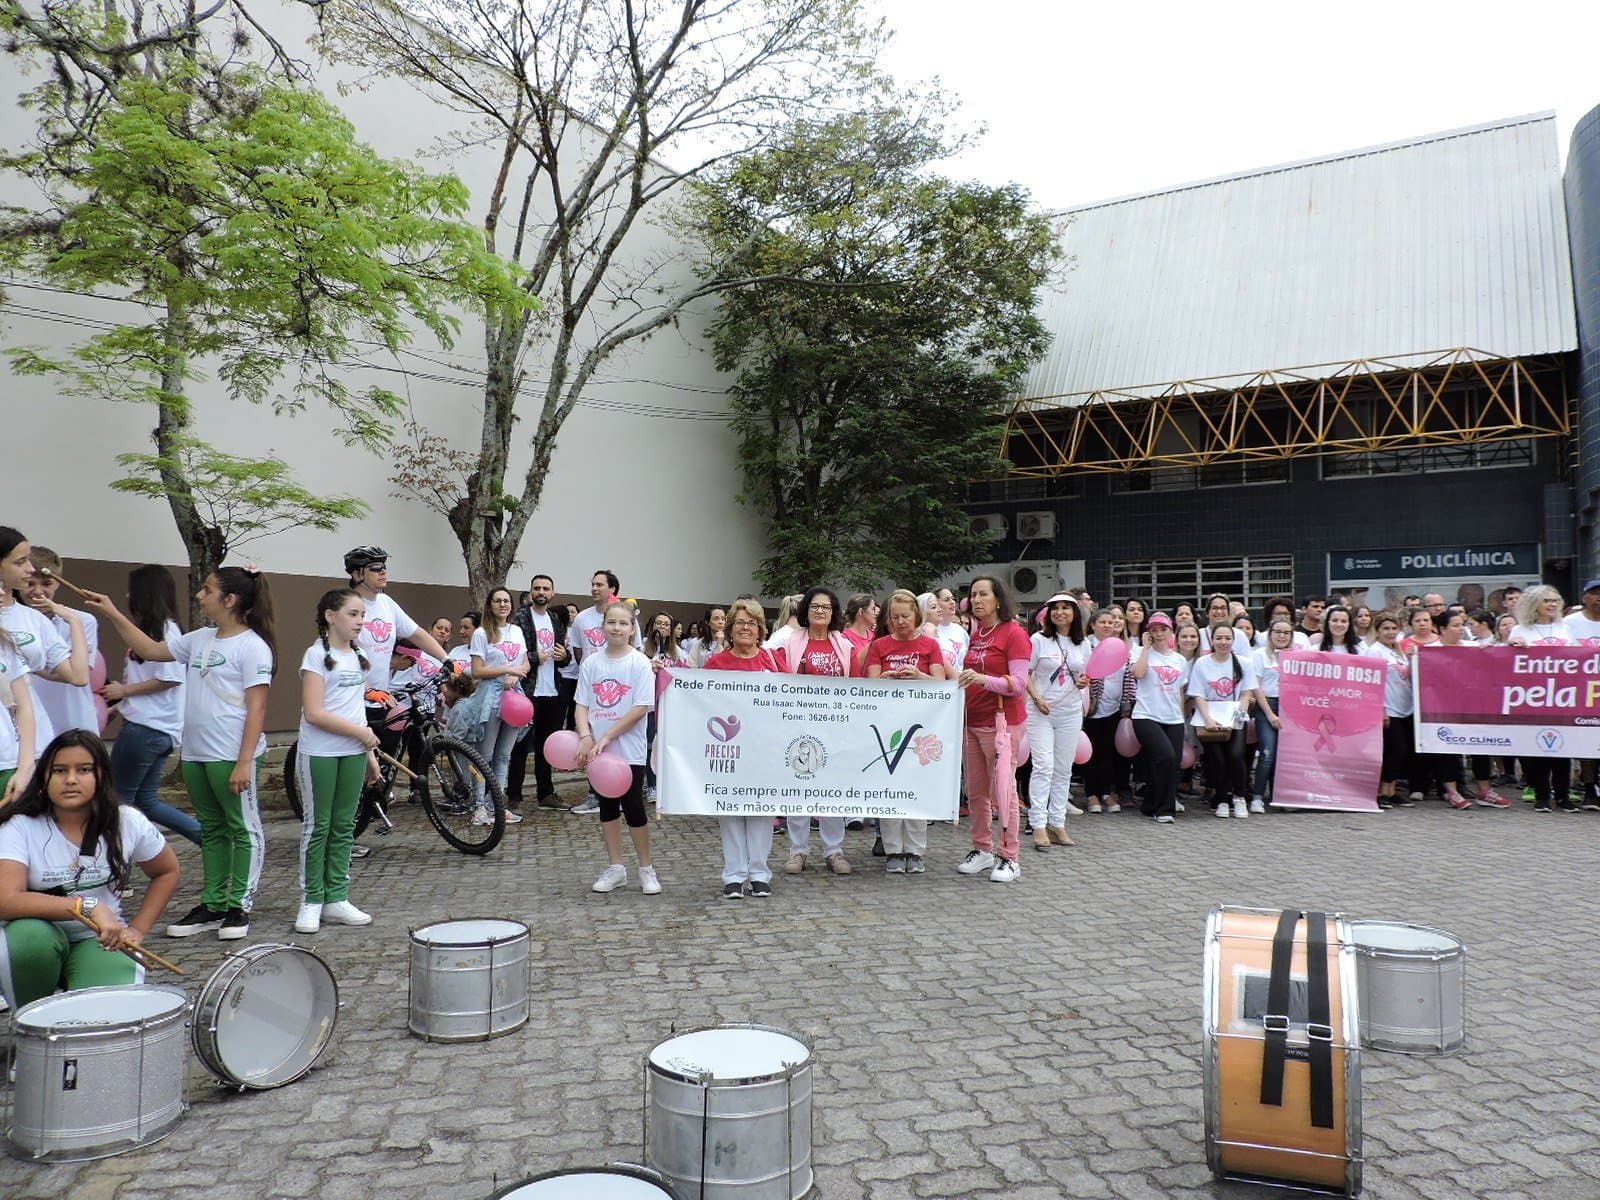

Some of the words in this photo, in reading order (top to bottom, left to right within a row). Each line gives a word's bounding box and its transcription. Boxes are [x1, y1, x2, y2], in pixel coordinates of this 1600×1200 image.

[1401, 549, 1516, 569] POLICLÍNICA
[1513, 654, 1579, 674] Entre
[1582, 653, 1600, 674] d
[1283, 659, 1342, 680] OUTUBRO
[1346, 665, 1382, 685] ROSA
[674, 678, 704, 690] Rede
[707, 680, 760, 693] Feminina
[764, 682, 778, 693] de
[781, 683, 830, 696] Combate
[833, 687, 847, 696] ao
[850, 686, 888, 698] Câncer
[891, 688, 905, 699] de
[908, 689, 951, 700] Tubarão
[1328, 687, 1362, 699] AMOR
[1501, 678, 1577, 715] pela
[753, 698, 770, 707] Rua
[772, 699, 794, 708] Isaac
[796, 700, 830, 710] Newton,
[849, 702, 878, 711] Centro
[1299, 696, 1329, 708] VOCÊ
[782, 712, 806, 721] Fone:
[808, 713, 850, 722] 3626-6151
[1469, 736, 1511, 744] CLÍNICA
[705, 743, 741, 759] PRECISO
[709, 759, 736, 774] VIVER
[704, 783, 728, 795] Fica
[731, 785, 778, 799] sempre
[781, 788, 801, 797] um
[804, 788, 842, 800] pouco
[845, 787, 861, 798] de
[864, 787, 918, 801] perfume,
[716, 800, 739, 812] Nas
[743, 801, 776, 813] mãos
[779, 803, 803, 815] que
[806, 802, 863, 814] oferecem
[866, 806, 907, 815] rosas...
